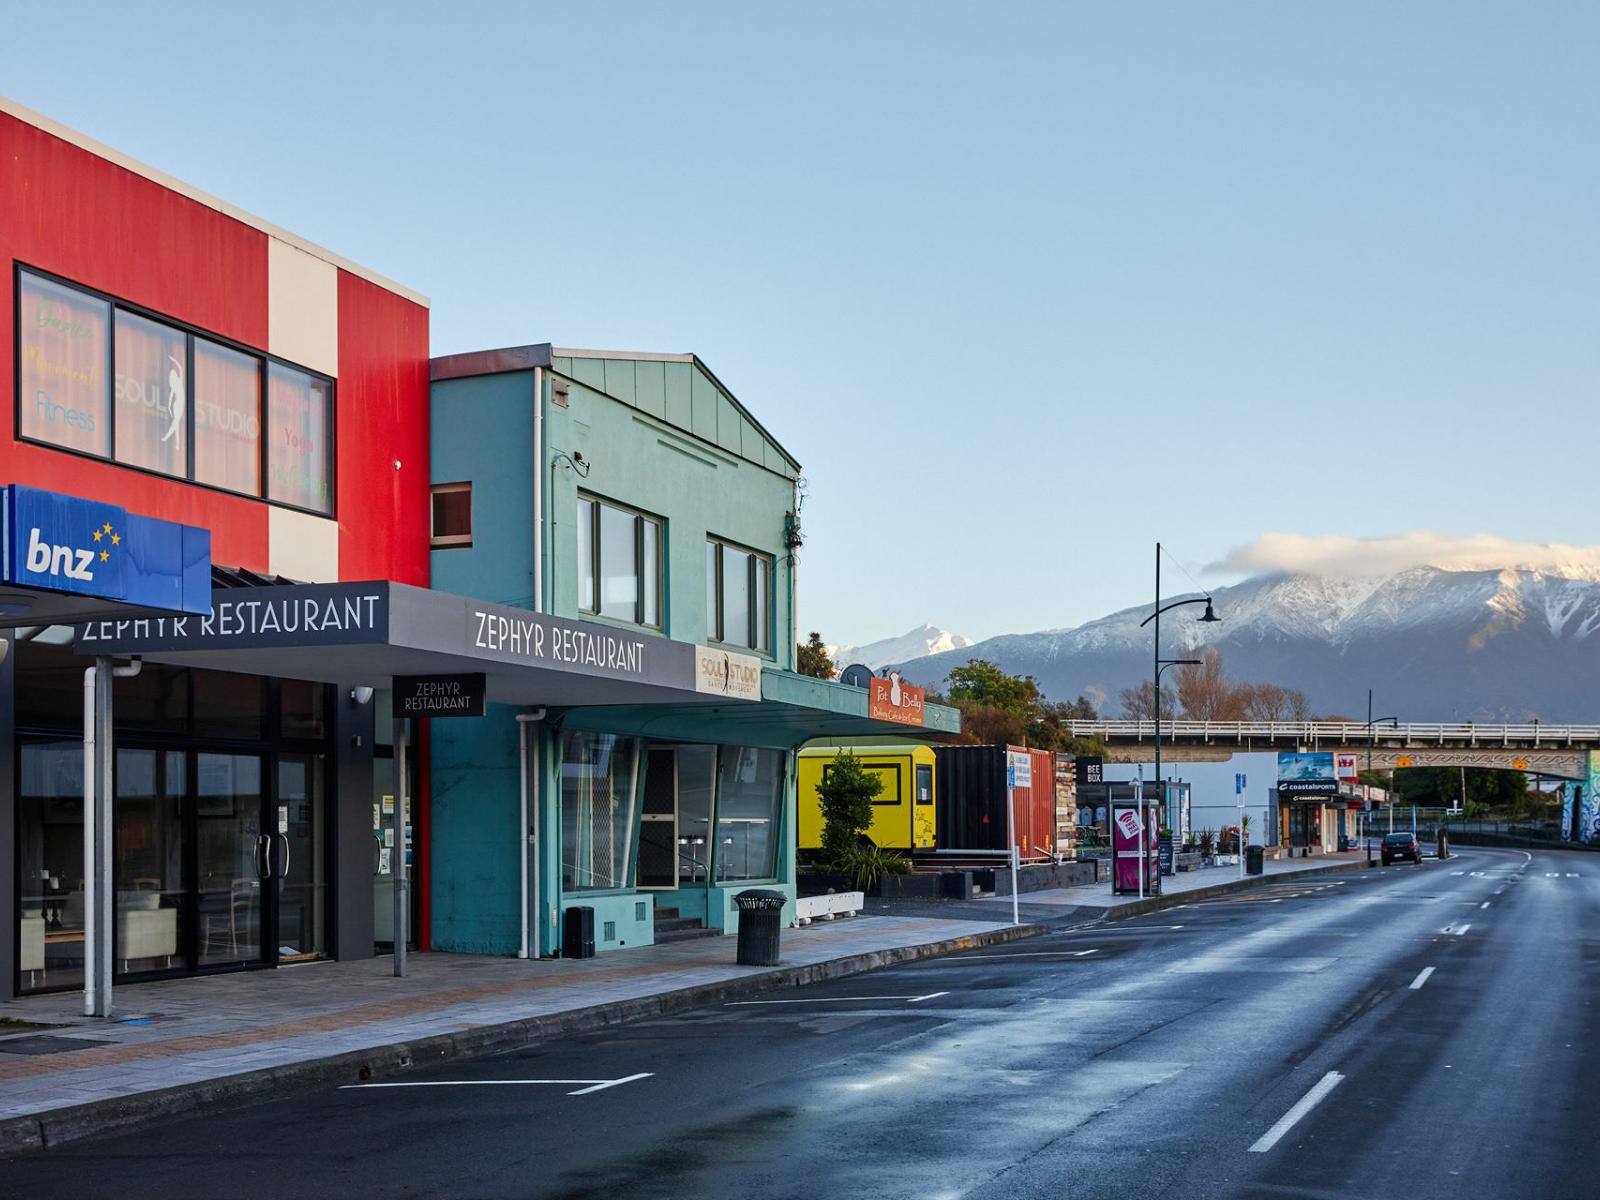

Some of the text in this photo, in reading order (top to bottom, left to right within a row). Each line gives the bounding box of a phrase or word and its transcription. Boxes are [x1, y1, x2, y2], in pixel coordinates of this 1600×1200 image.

[115, 374, 170, 413] SOUL
[195, 400, 259, 440] STUDIO
[27, 528, 94, 581] bnz
[201, 595, 380, 637] RESTAURANT
[475, 612, 644, 673] ZEPHYR RESTAURANT
[702, 656, 758, 684] SOUL STUDIO
[405, 695, 471, 710] RESTAURANT
[416, 682, 461, 697] ZEPHYR
[877, 685, 921, 712] Pot Belly
[1087, 764, 1100, 773] BEE
[1087, 773, 1101, 783] BOX
